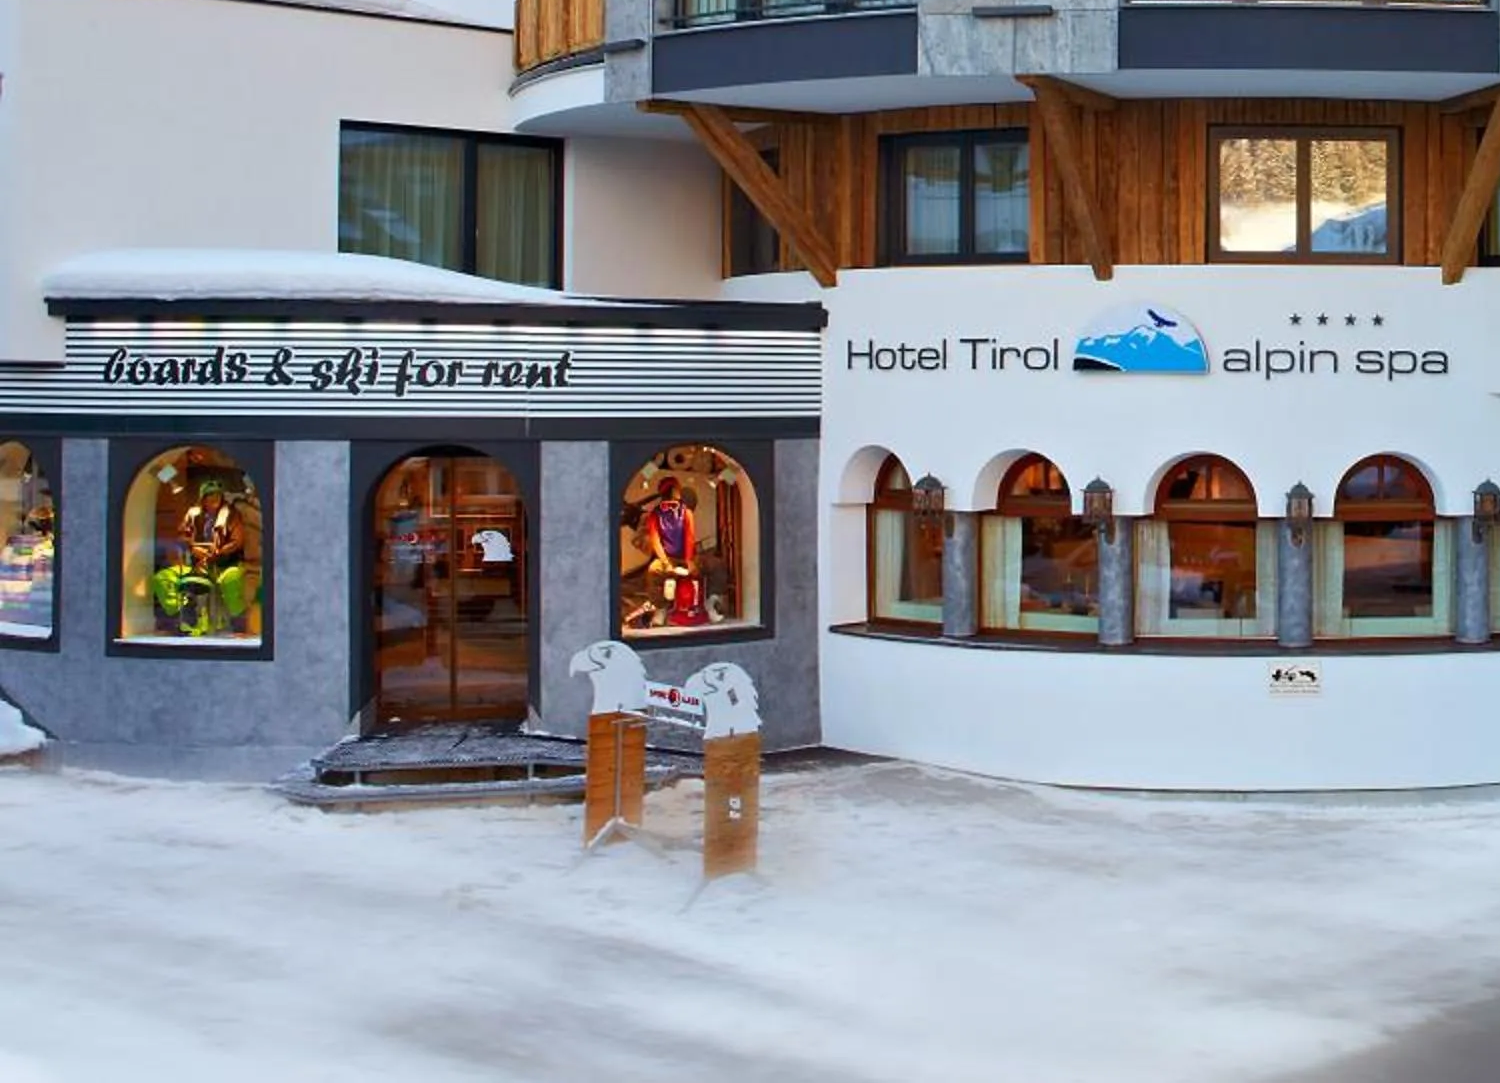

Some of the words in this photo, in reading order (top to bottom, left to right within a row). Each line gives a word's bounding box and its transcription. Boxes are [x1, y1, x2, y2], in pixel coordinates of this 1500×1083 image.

[102, 346, 248, 386] boards
[263, 347, 295, 386] &
[309, 347, 381, 396] ski
[395, 348, 465, 398] for
[481, 351, 574, 389] rent
[847, 338, 948, 371] Hotel
[959, 338, 1060, 371] Tirol
[1222, 339, 1340, 381] alpin
[1354, 349, 1450, 382] spa
